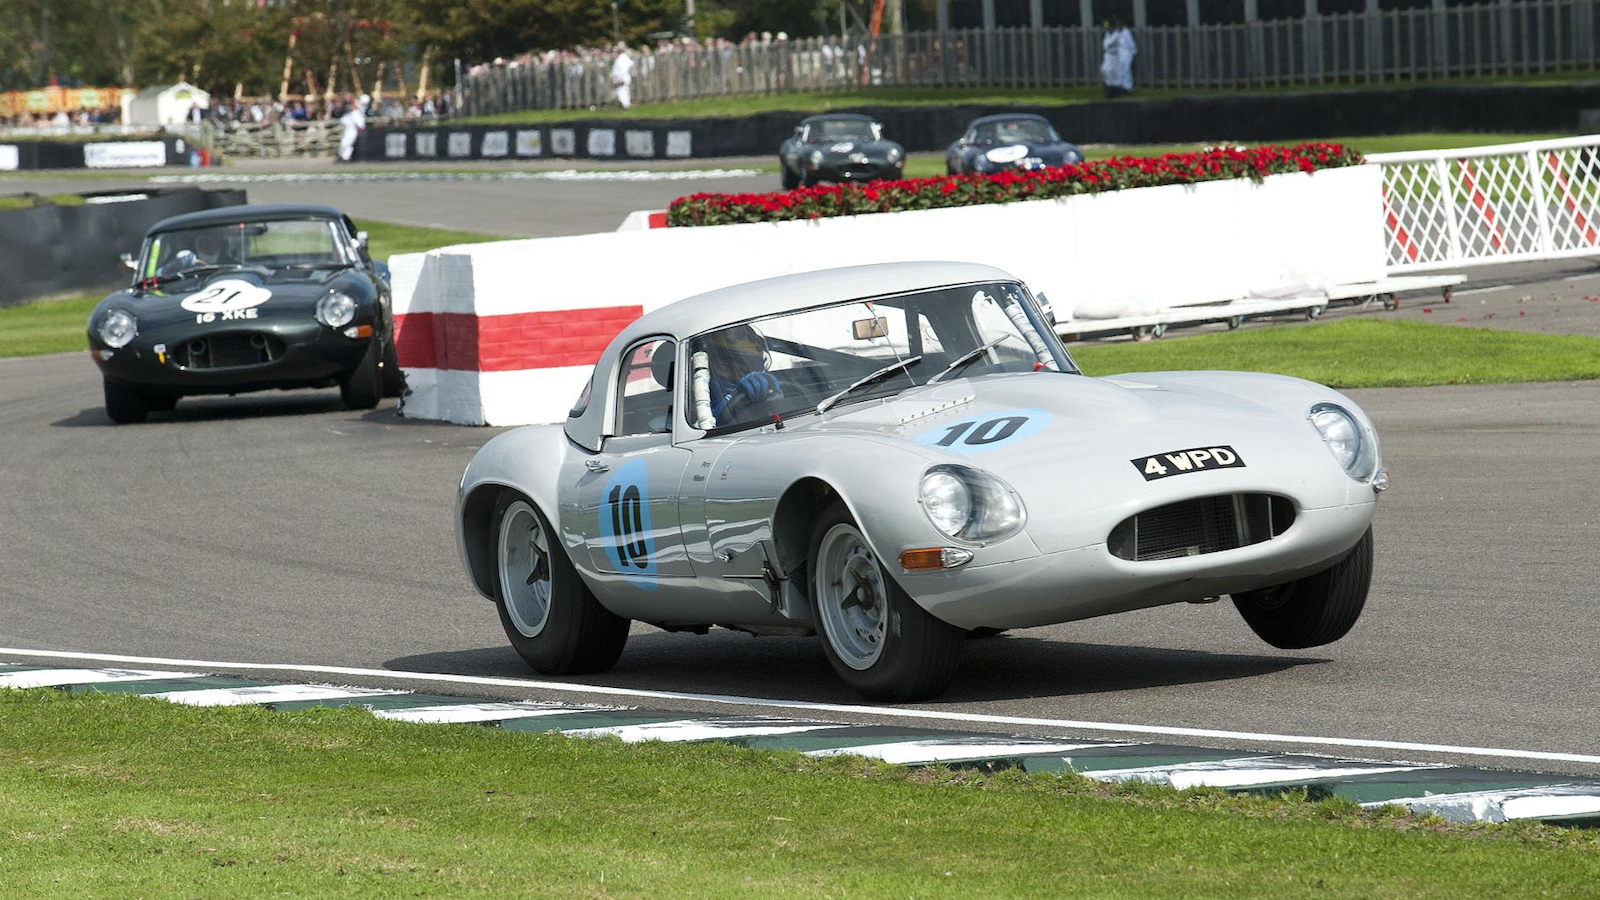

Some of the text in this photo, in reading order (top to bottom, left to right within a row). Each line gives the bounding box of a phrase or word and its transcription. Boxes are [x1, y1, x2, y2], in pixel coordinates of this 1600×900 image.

[194, 288, 241, 304] 21
[221, 308, 259, 321] XKE
[934, 416, 1030, 447] 10
[1144, 448, 1236, 475] 4 WPD
[608, 484, 648, 569] 10
